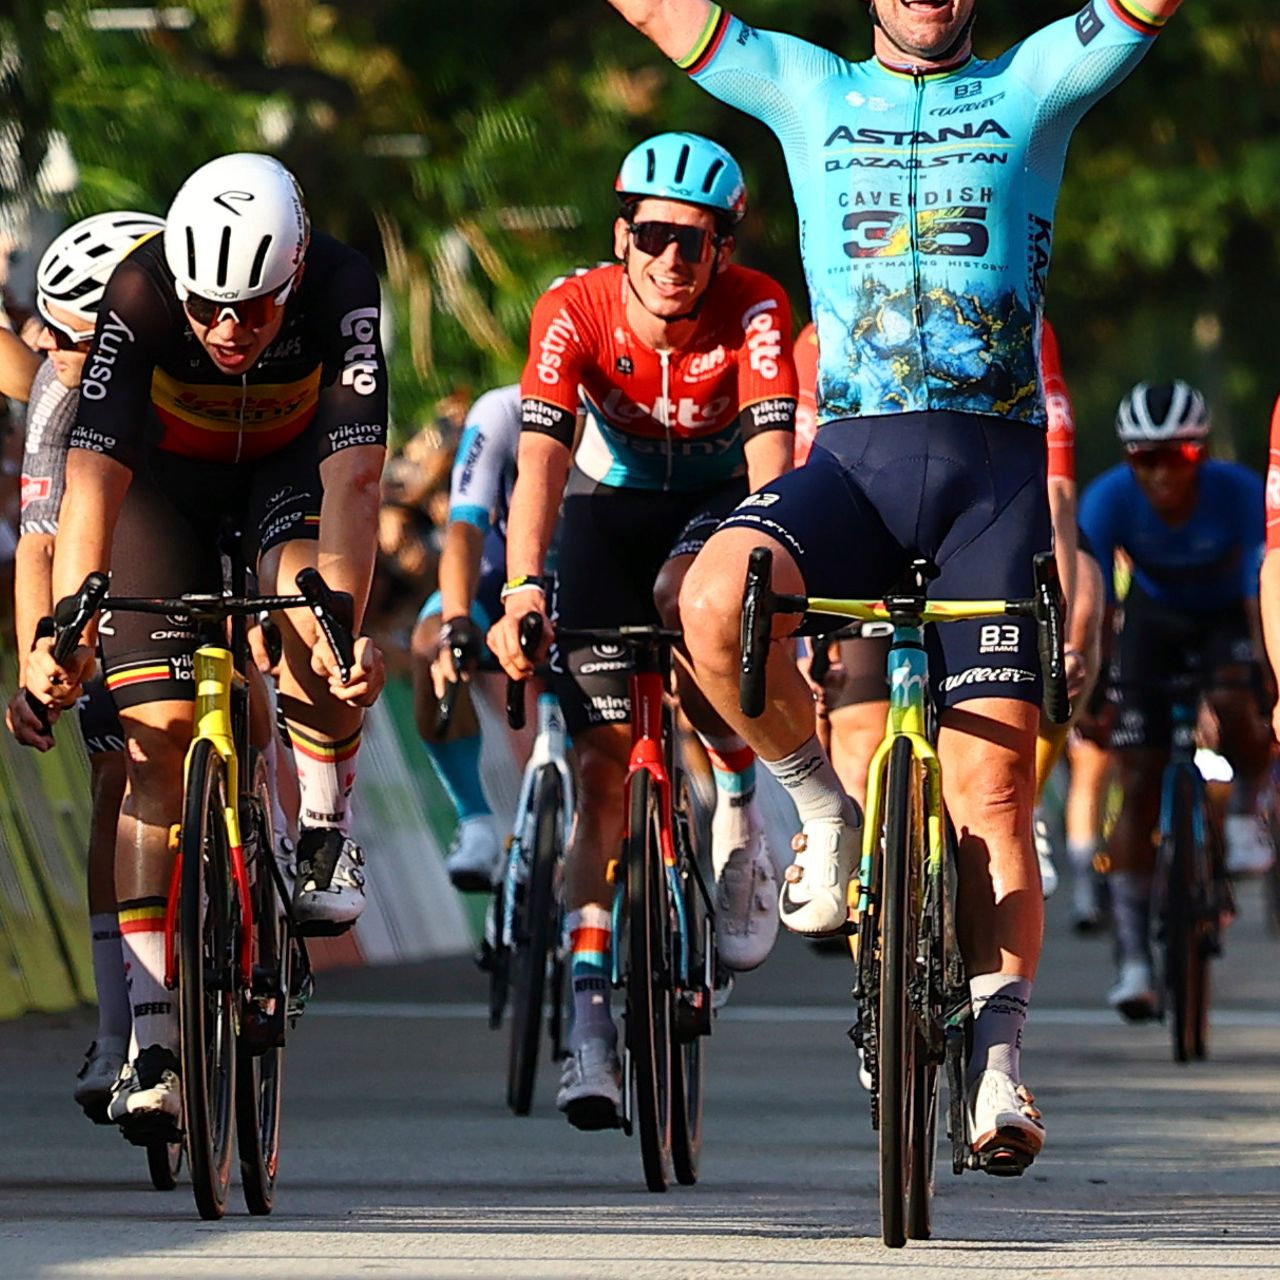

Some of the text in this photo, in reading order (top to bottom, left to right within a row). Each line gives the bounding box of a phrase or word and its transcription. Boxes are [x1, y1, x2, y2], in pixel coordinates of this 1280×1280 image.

[824, 118, 1011, 147] ASTANA
[825, 152, 1009, 172] QAZAQSTAN
[838, 187, 994, 207] CAVENDISH
[841, 206, 991, 259] 35
[742, 300, 782, 379] lotto
[339, 307, 379, 396] lotto
[749, 400, 796, 416] viking
[754, 409, 790, 426] lotto
[327, 424, 383, 445] viking
[330, 435, 377, 453] lotto
[980, 624, 1020, 646] B3
